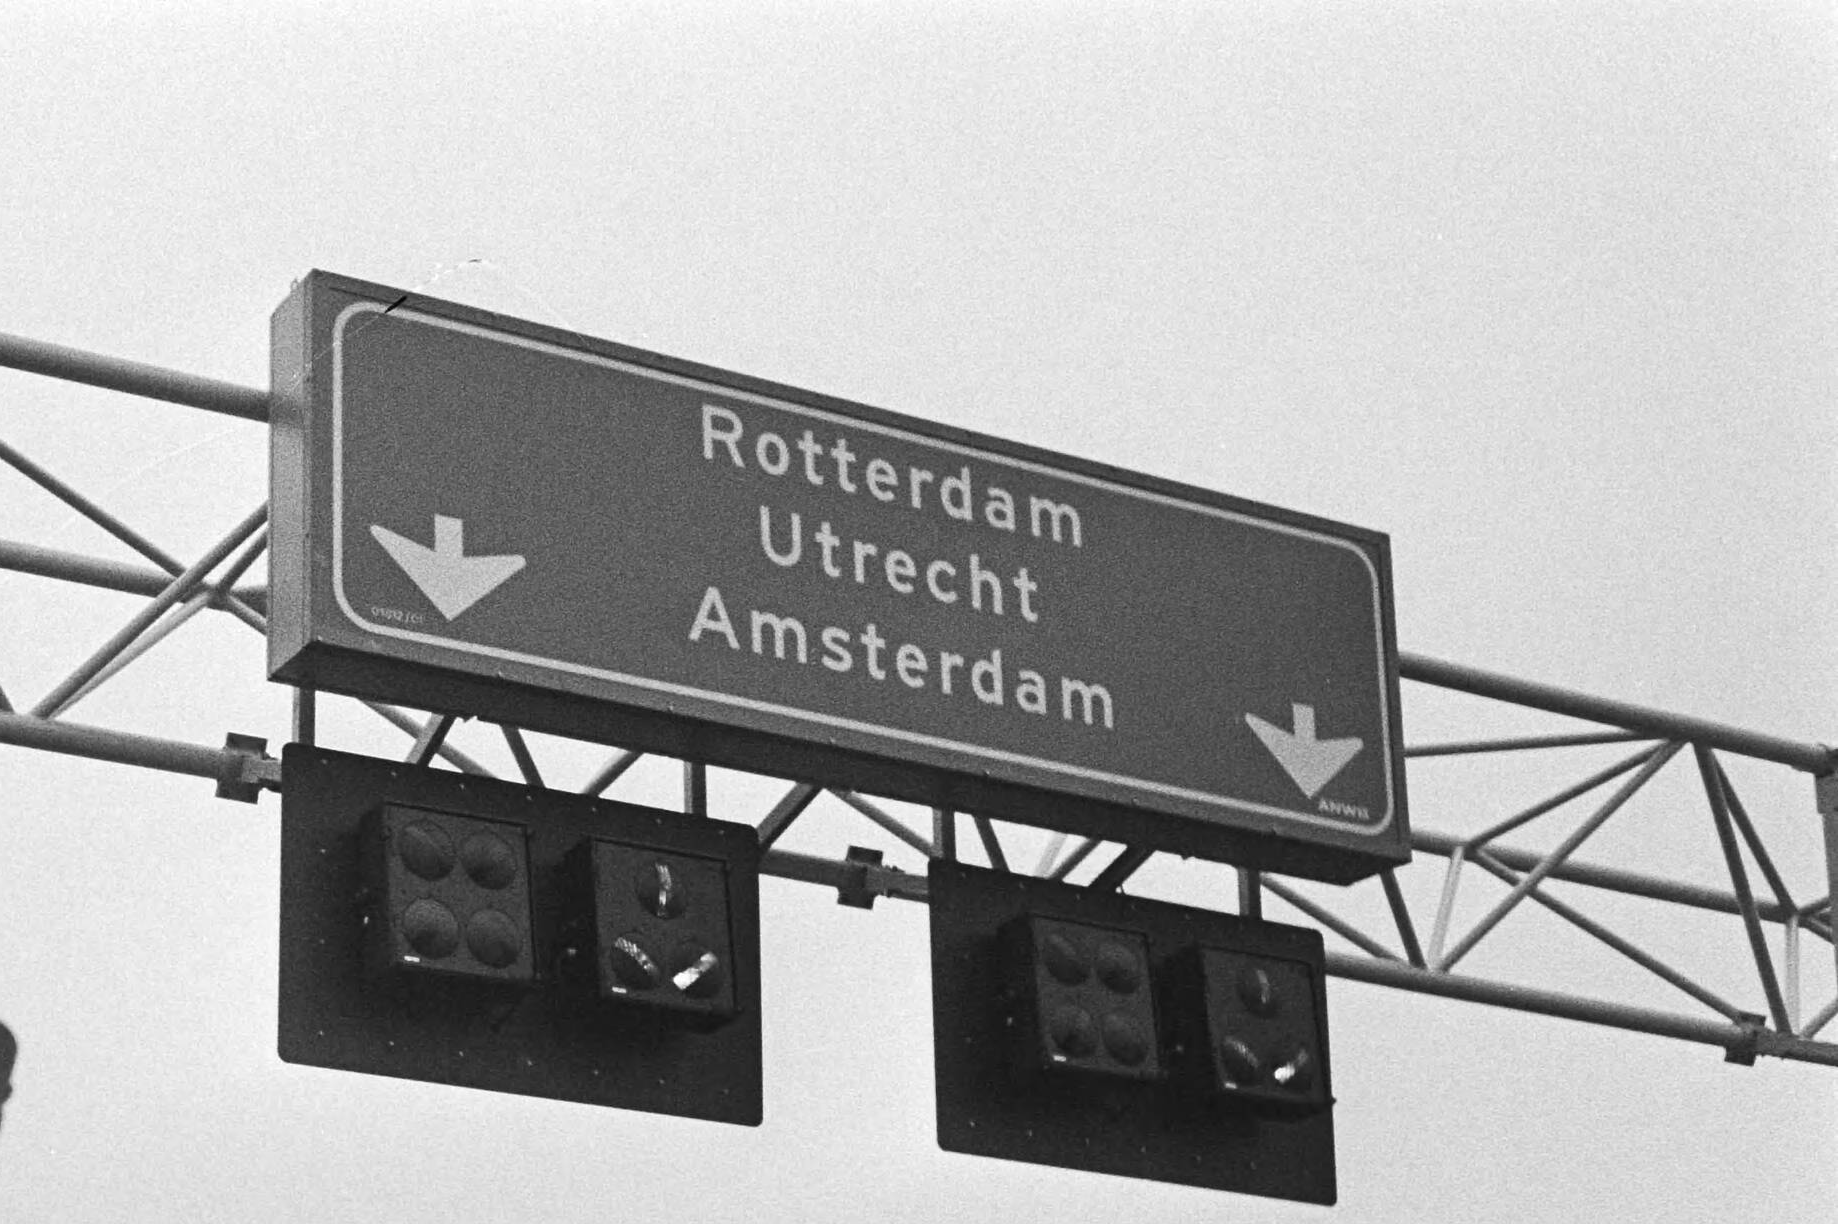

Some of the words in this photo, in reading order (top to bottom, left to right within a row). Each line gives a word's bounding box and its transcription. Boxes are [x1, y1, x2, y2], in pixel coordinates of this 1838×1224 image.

[702, 402, 1083, 547] Rotterdam
[759, 504, 1039, 623] Utrecht
[688, 586, 1114, 729] Amsterdam
